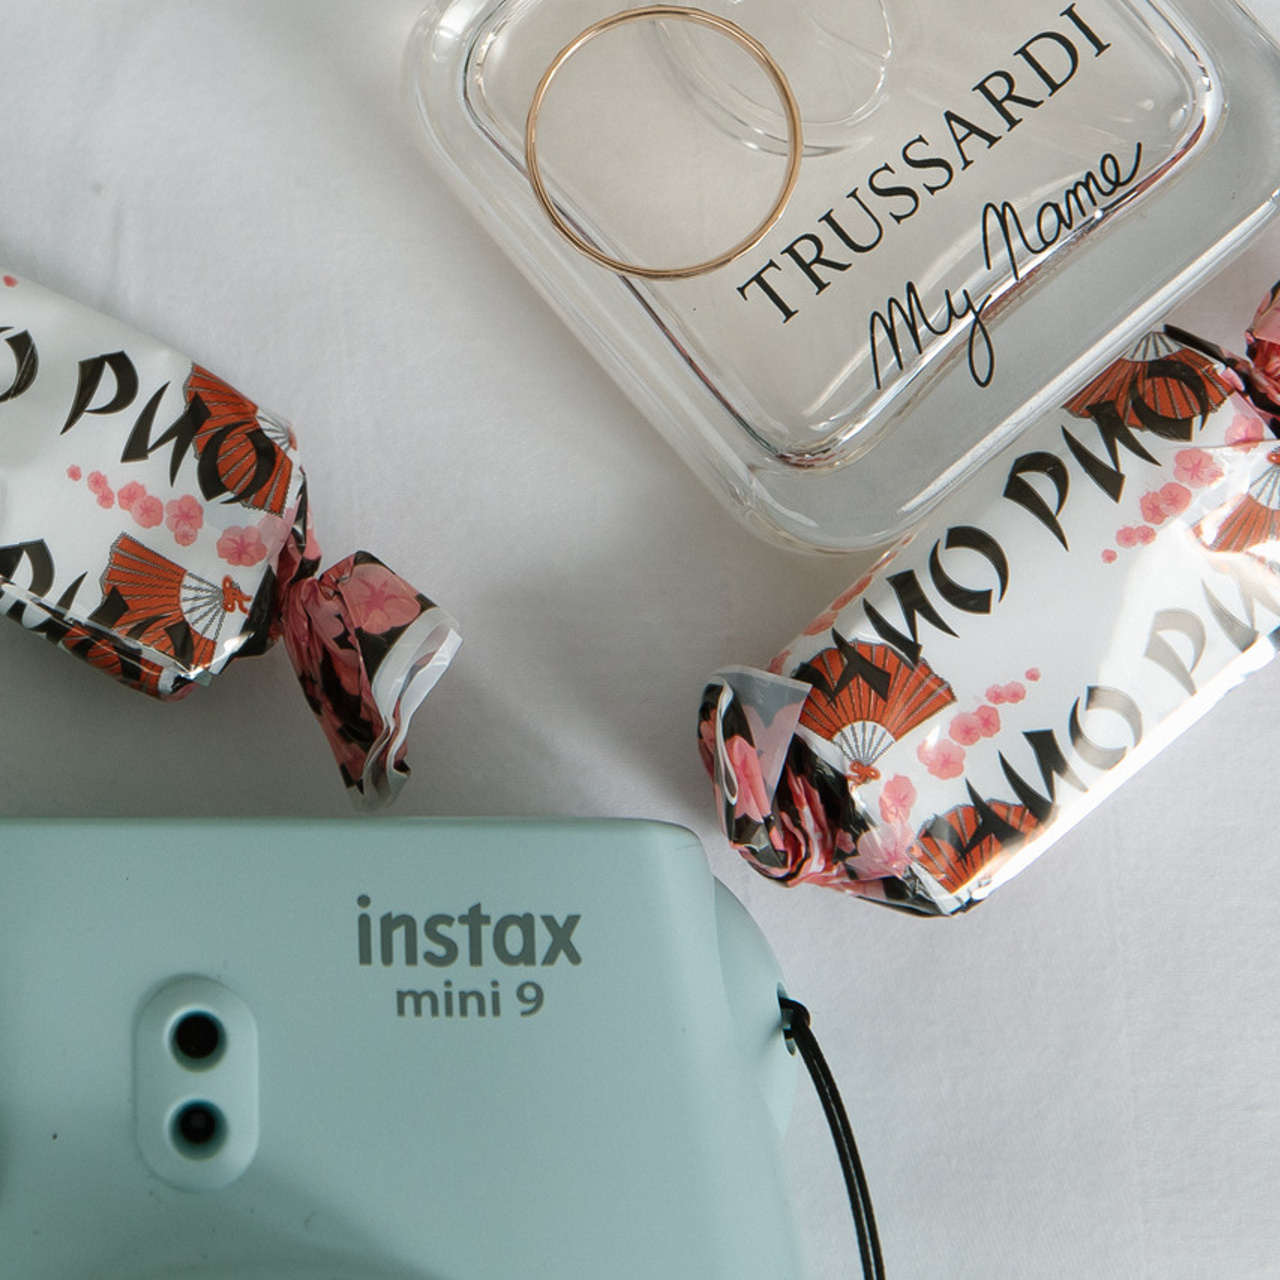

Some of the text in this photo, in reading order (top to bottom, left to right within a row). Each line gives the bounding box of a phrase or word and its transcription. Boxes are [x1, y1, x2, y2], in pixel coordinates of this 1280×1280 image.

[735, 2, 1112, 324] TRUSSARDI
[869, 281, 993, 391] My
[59, 350, 279, 504] РИО
[1002, 358, 1211, 552] РИО
[356, 894, 583, 968] instax
[396, 980, 544, 1018] mini 9
